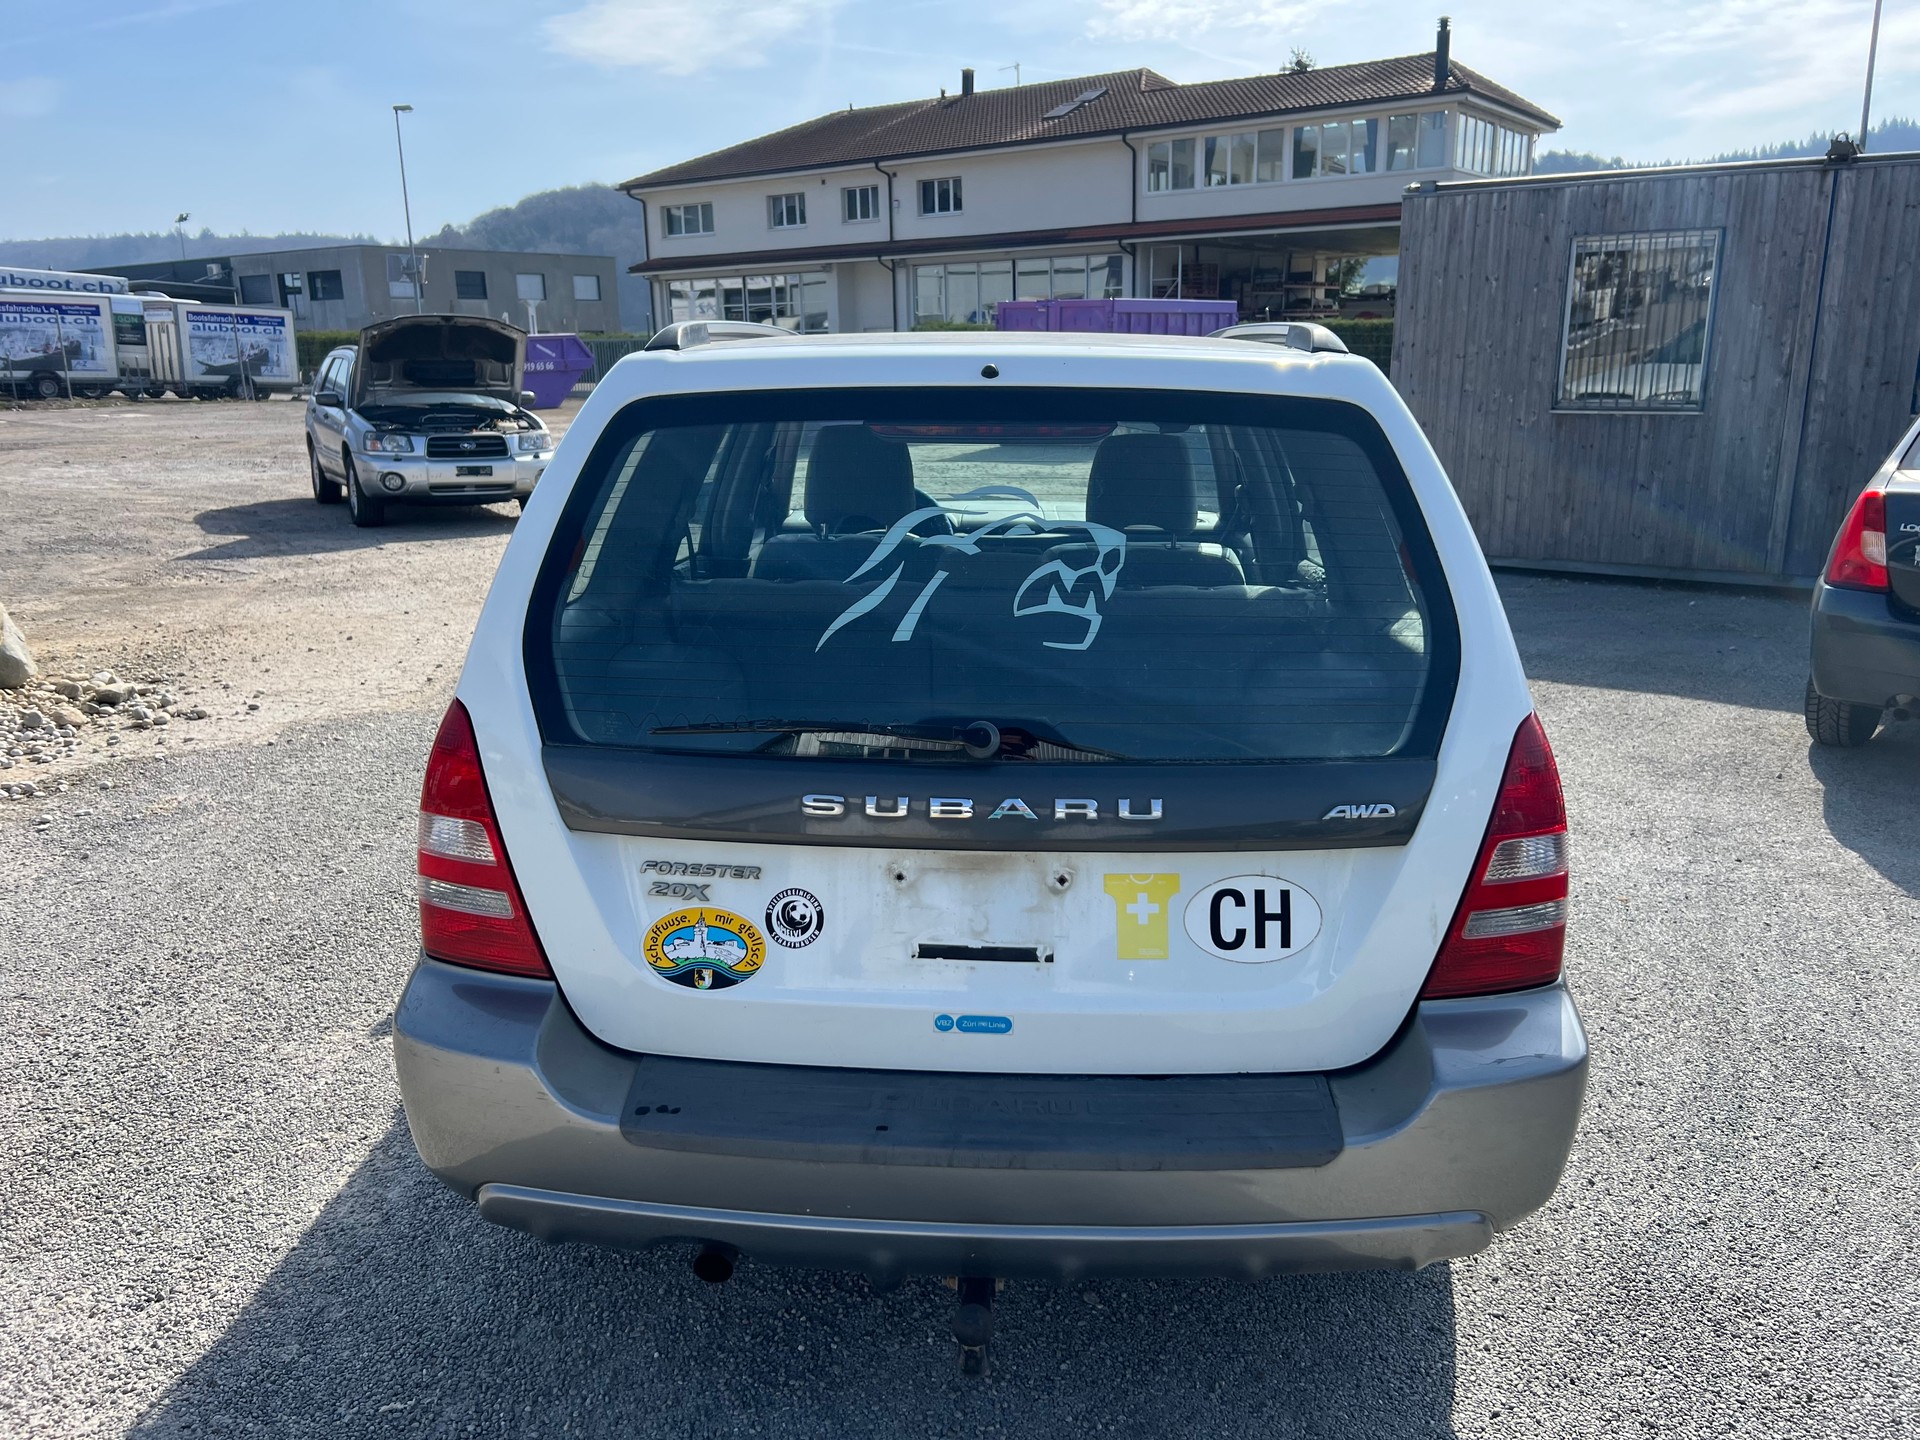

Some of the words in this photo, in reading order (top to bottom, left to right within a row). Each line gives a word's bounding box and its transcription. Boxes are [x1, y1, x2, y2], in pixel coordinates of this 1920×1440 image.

[192, 323, 283, 335] aluboot.ch
[536, 362, 545, 371] 65
[546, 362, 554, 371] 66
[1900, 523, 1920, 532] LO
[801, 794, 1163, 820] SUBARU
[1322, 803, 1396, 820] AWD
[639, 860, 762, 880] FORESTER
[715, 913, 735, 926] mir
[1209, 887, 1292, 951] CH
[936, 1019, 952, 1027] VBZ
[988, 1021, 1006, 1029] Linie
